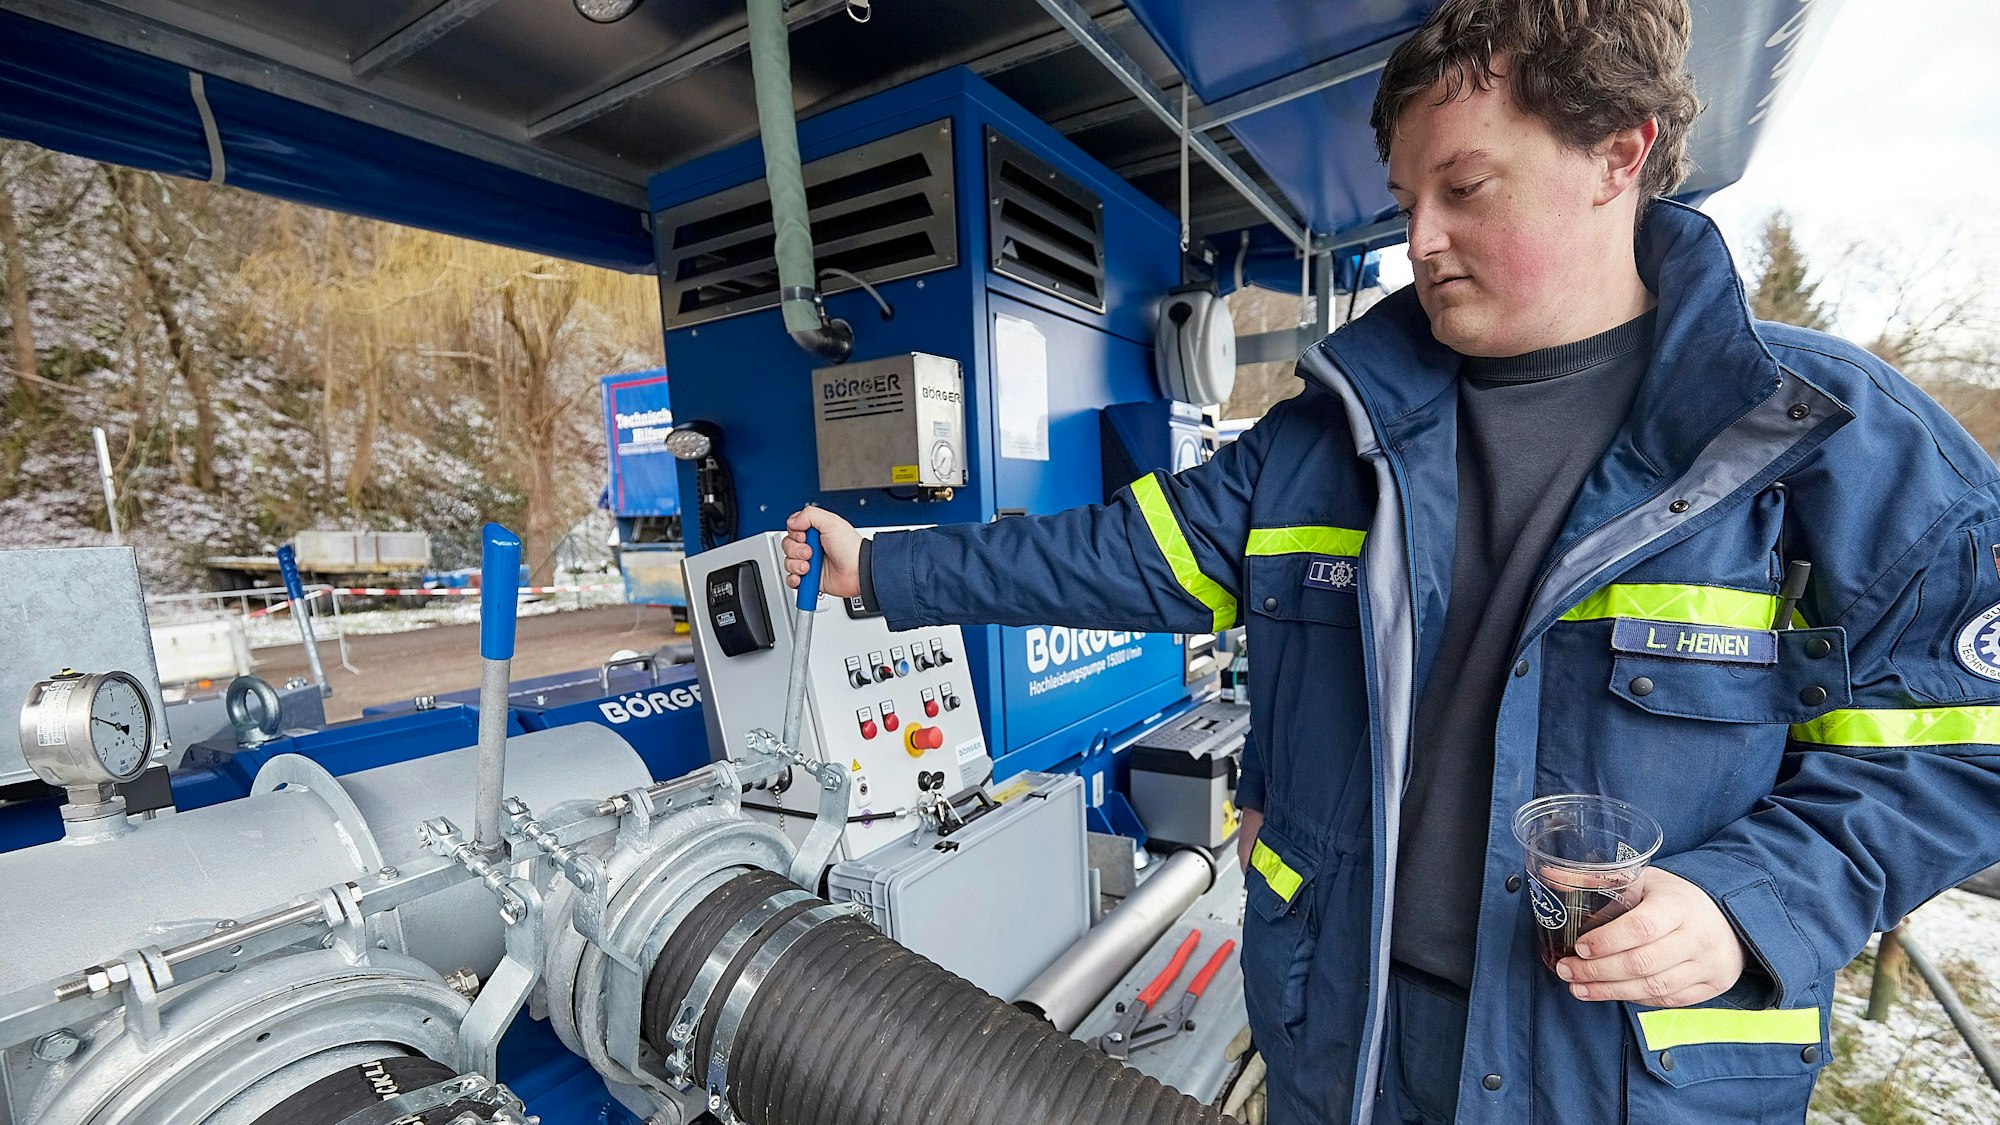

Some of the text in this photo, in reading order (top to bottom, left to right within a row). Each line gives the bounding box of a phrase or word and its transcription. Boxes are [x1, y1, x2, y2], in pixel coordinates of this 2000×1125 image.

[823, 373, 901, 400] BÖRGER
[922, 386, 961, 404] BÖRGER
[1645, 627, 1749, 657] L. HEINEN
[1029, 659, 1107, 697] Hochleistungspumpe
